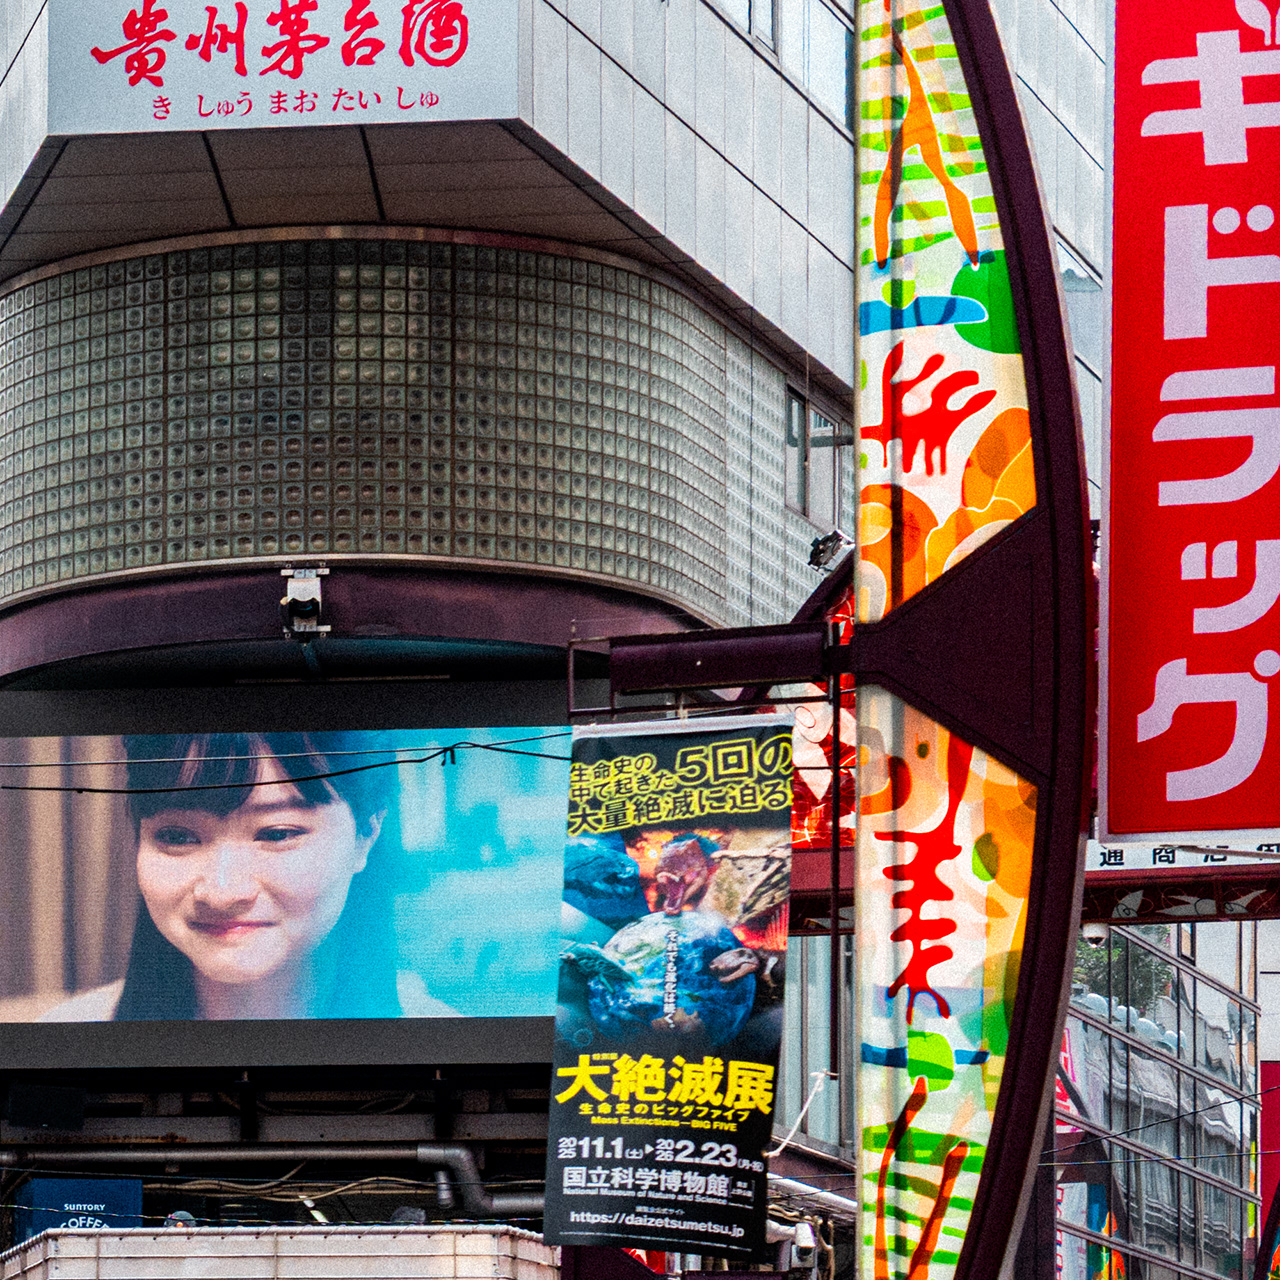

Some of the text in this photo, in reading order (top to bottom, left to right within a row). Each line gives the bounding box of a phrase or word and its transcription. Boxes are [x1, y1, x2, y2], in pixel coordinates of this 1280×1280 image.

[153, 85, 440, 120] き しゅう まお たい しゅ
[570, 754, 657, 784] 生命史の
[676, 734, 792, 785] 5回の
[570, 771, 677, 801] 中で起きた
[555, 1053, 774, 1115] 大絶滅展
[579, 1103, 750, 1122] 生命史のビッグファイブ
[713, 1122, 738, 1132] FIVE
[563, 1166, 729, 1197] 国立科学博物館
[570, 1211, 744, 1237] https://daizetsumetsu.jp
